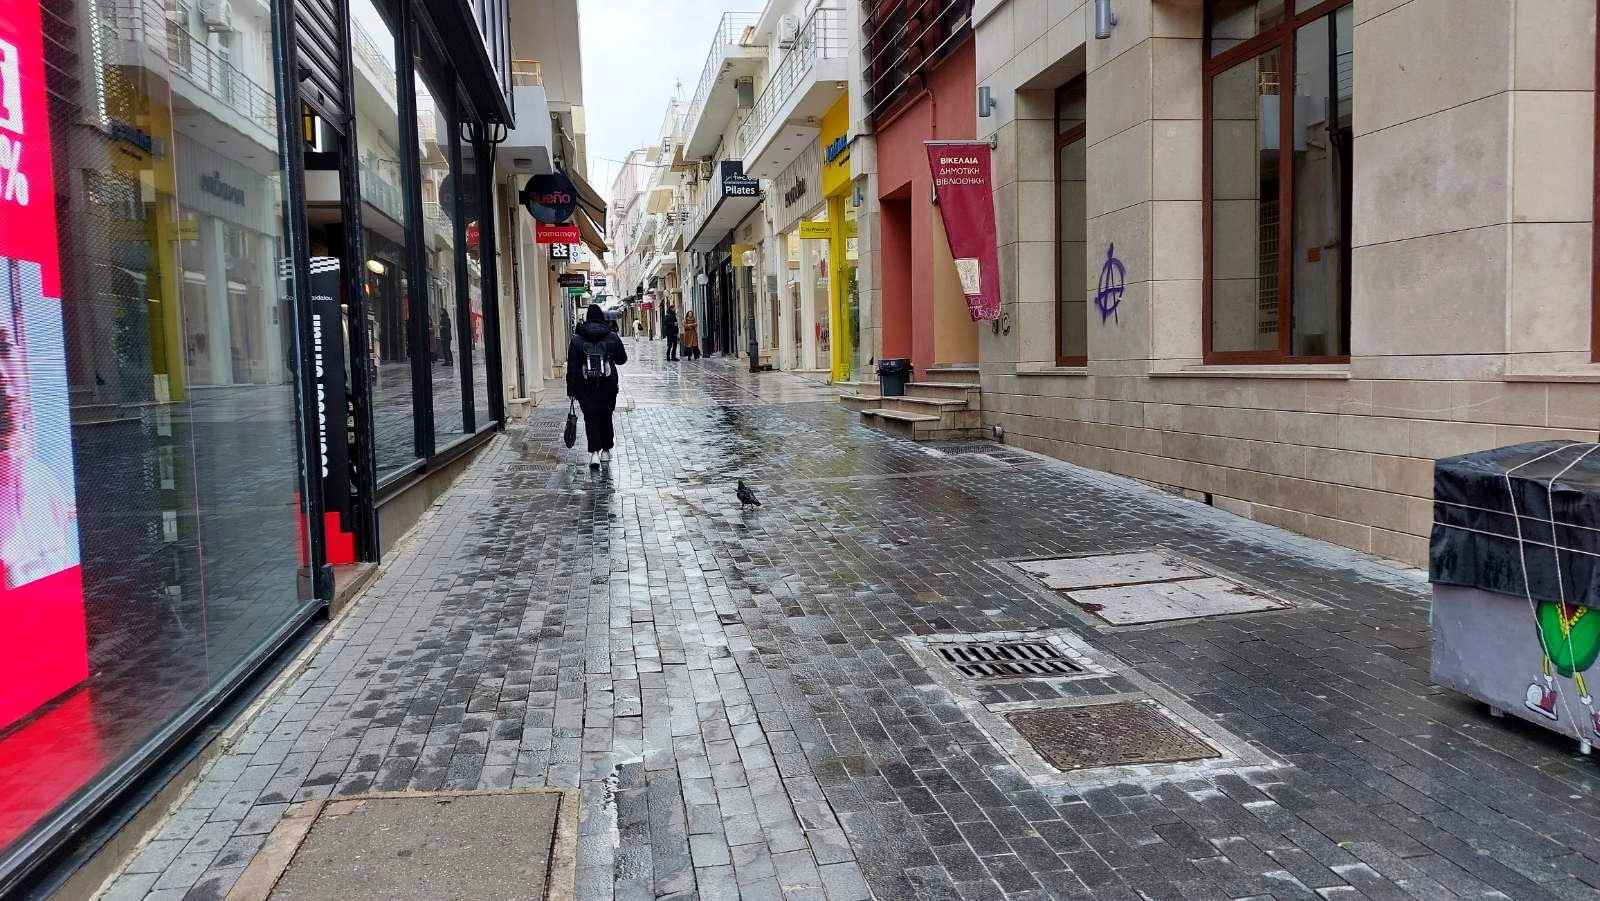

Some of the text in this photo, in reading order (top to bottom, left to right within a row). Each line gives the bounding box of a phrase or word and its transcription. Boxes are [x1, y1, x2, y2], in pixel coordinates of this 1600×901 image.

[940, 157, 979, 165] ΒΙΚΕΛΑΙΑ
[939, 167, 980, 175] ΔΗΜΟΤΙΚΗ
[936, 177, 985, 186] ΒΙΒΛΙΟΘΗΚΗ
[725, 185, 756, 195] Pilates
[530, 190, 571, 204] Sueño
